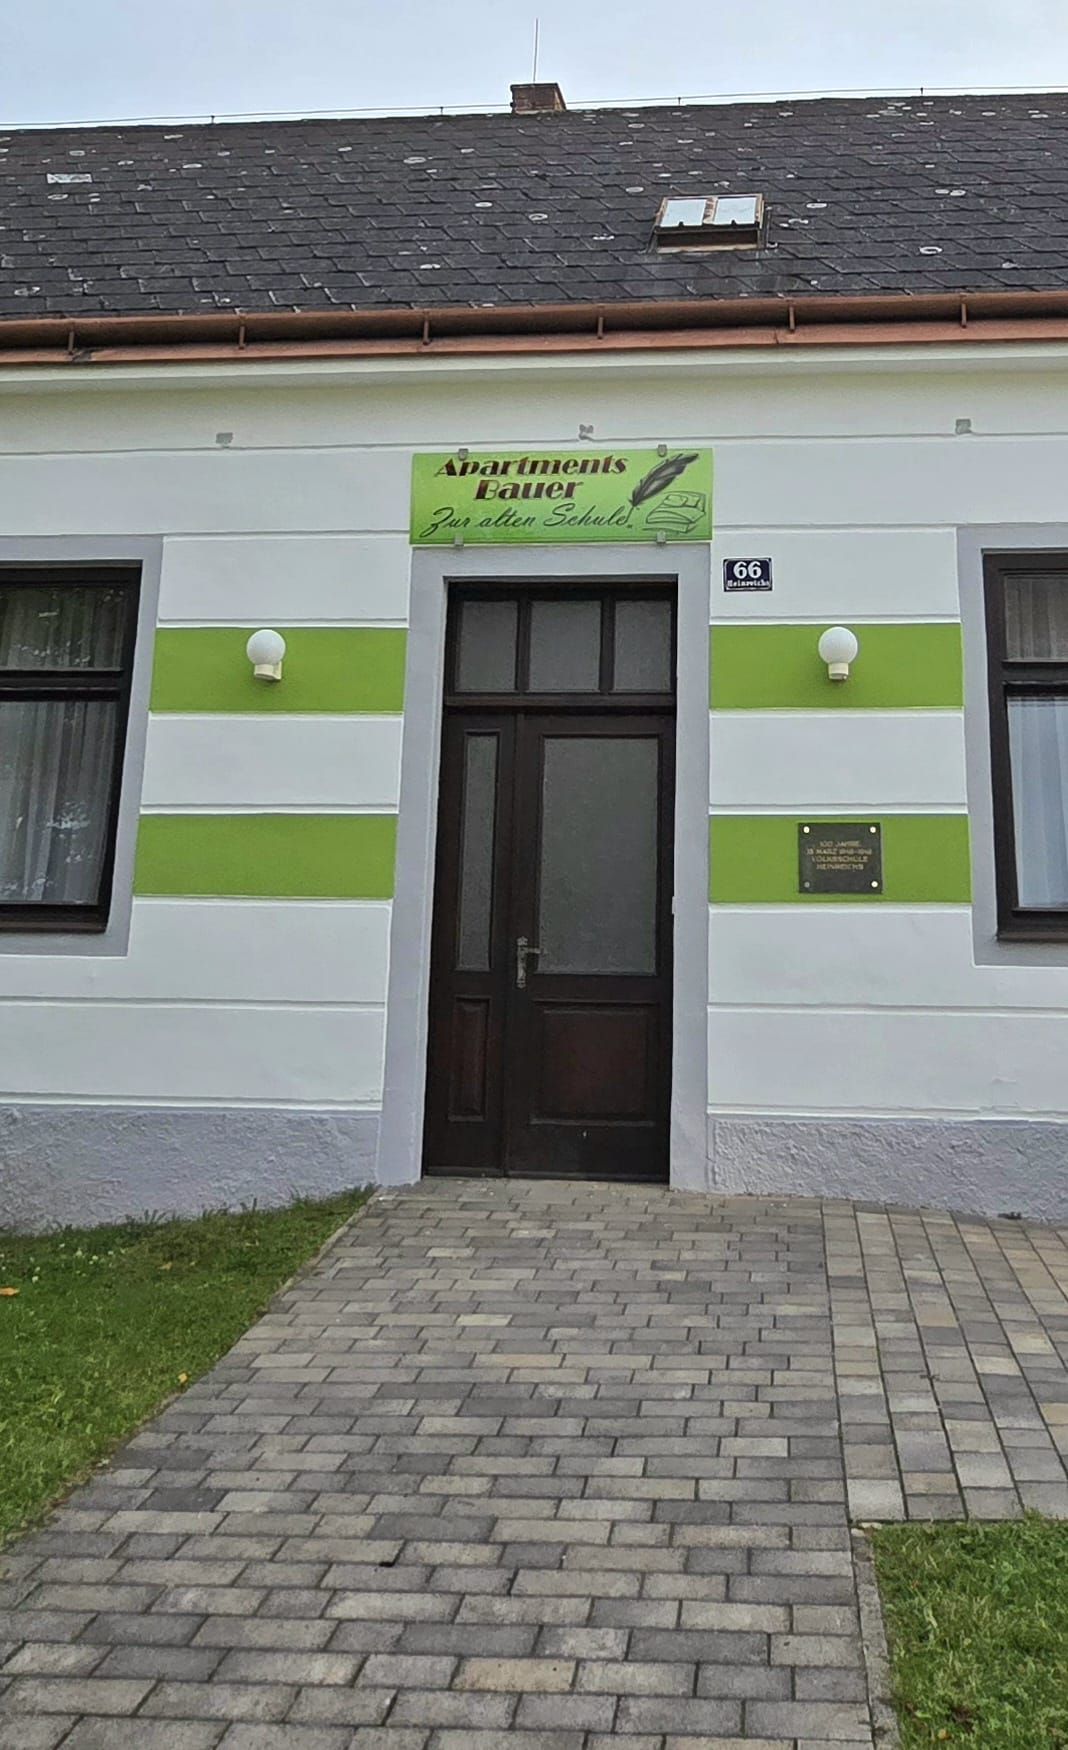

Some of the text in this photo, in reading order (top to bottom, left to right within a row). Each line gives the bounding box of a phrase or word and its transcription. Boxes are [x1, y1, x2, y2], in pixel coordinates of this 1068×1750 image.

[434, 454, 628, 478] Apartments
[473, 479, 584, 501] Bauer
[419, 503, 629, 538] Zur alten Schule
[733, 561, 762, 579] 66
